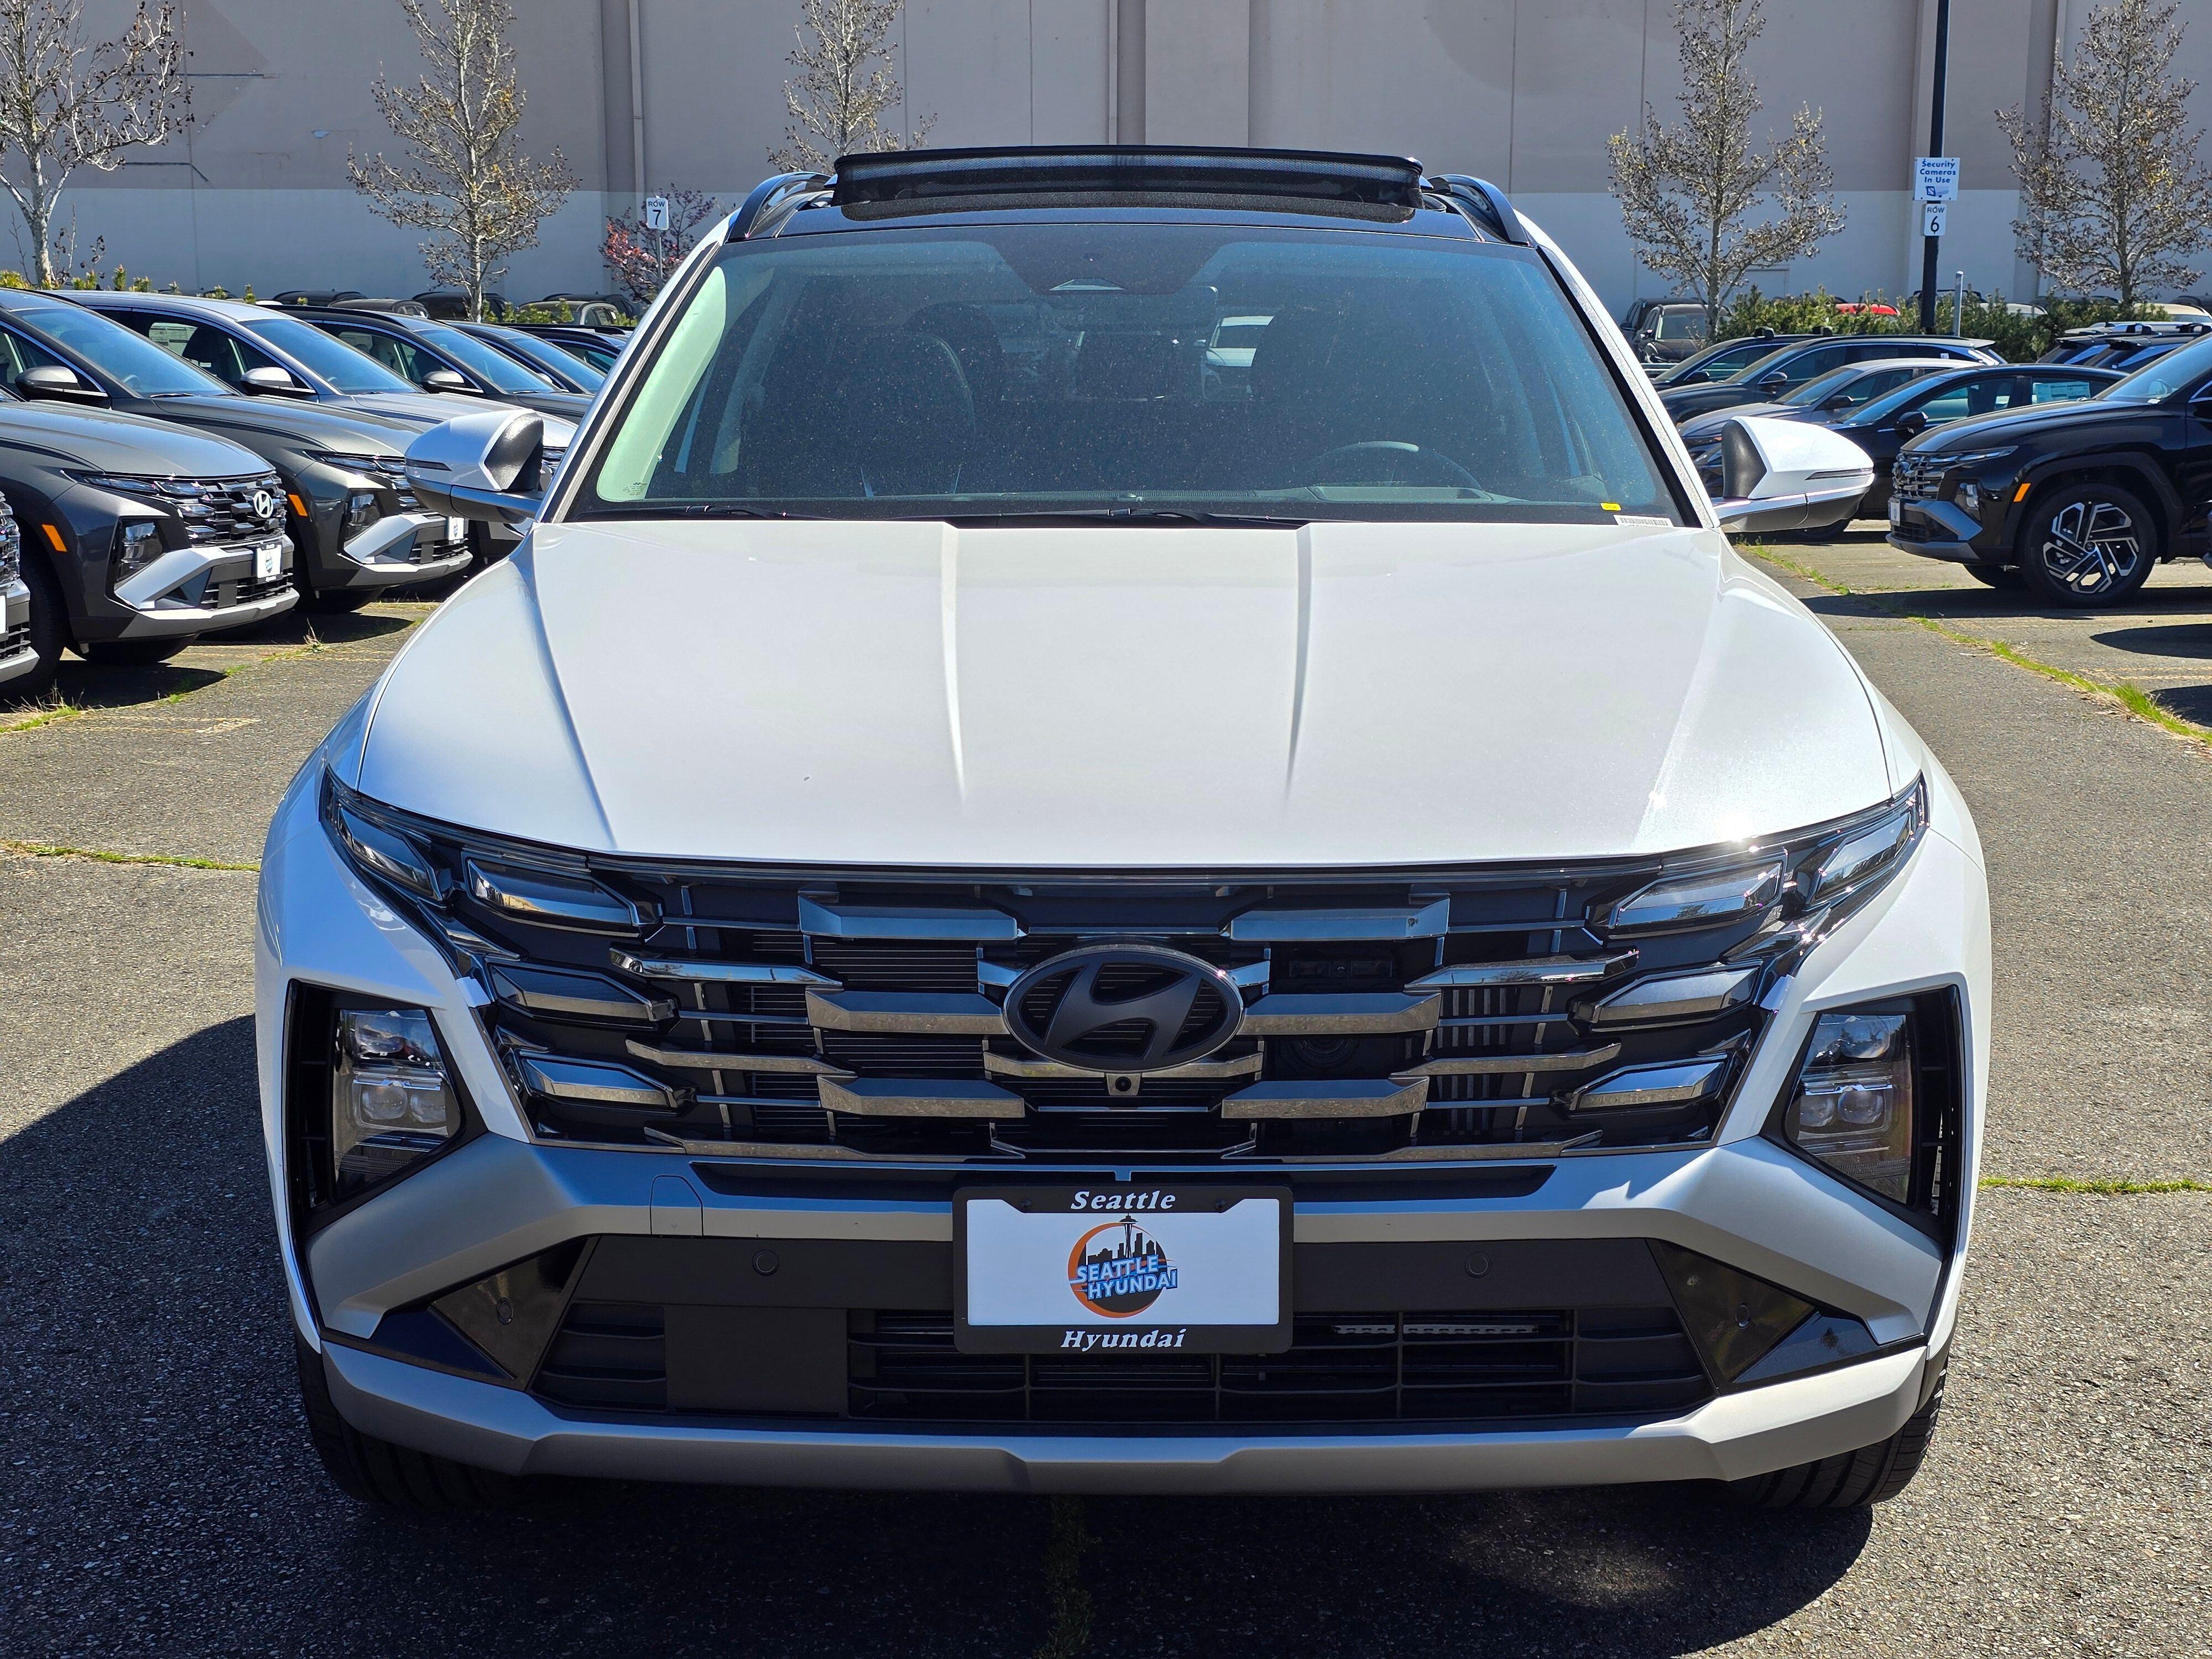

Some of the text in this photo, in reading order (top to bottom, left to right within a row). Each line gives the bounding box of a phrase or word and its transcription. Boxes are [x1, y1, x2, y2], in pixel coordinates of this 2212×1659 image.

[1922, 160, 1955, 169] Security
[653, 209, 661, 226] 7
[1930, 216, 1940, 232] 6
[1070, 1190, 1176, 1210] Seattle
[1077, 1255, 1159, 1285] SEATTLE
[1088, 1269, 1178, 1301] HYUNDAI
[1060, 1328, 1187, 1352] Hyundai
